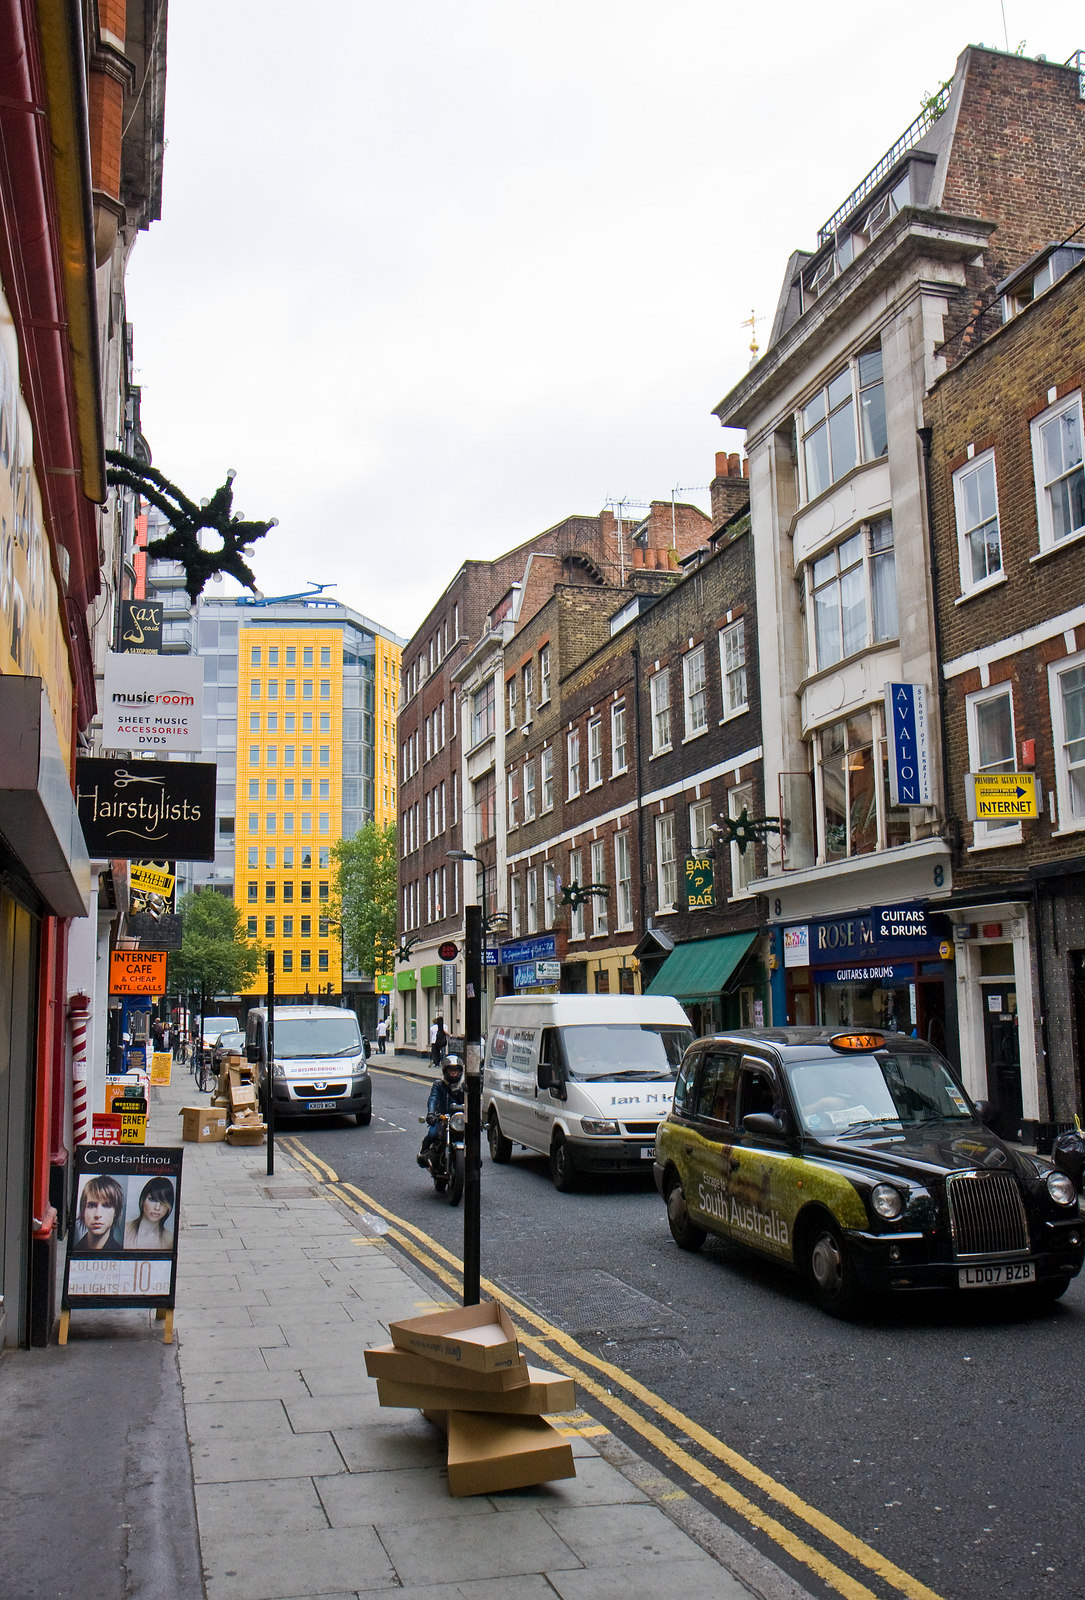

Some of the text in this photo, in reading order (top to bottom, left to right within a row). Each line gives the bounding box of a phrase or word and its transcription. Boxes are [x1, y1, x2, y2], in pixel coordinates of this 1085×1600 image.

[123, 605, 160, 643] Sax
[112, 691, 194, 706] musicroom
[118, 716, 188, 725] SHEET MUSIC
[117, 726, 188, 735] ACCESSORIES
[139, 736, 166, 744] DVDS
[897, 687, 914, 800] AVALON
[76, 784, 201, 832] Hairstylists
[979, 801, 1031, 813] INTERNET
[686, 860, 710, 870] BAR
[933, 864, 944, 887] 8
[139, 876, 162, 887] UNION
[688, 895, 713, 905] BAR
[774, 898, 782, 916] 8
[881, 911, 925, 921] GUITARS
[818, 921, 874, 950] ROSE M
[880, 925, 927, 936] & DRUMS
[114, 953, 164, 962] INTERNET
[126, 965, 152, 973] CAFE
[836, 966, 893, 980] GUITARS & DRUMS
[847, 1037, 878, 1048] TAXI
[611, 1093, 673, 1105] Ian Nic
[122, 1115, 145, 1125] ERNET
[92, 1128, 119, 1138] EET
[121, 1128, 138, 1138] PEN
[84, 1150, 171, 1165] Constantinou
[703, 1170, 726, 1191] Escape to
[698, 1183, 789, 1244] South Australia
[70, 1261, 116, 1271] COLOUR
[965, 1265, 1030, 1284] LD07 BZB
[68, 1282, 119, 1294] HI-LIGHTS
